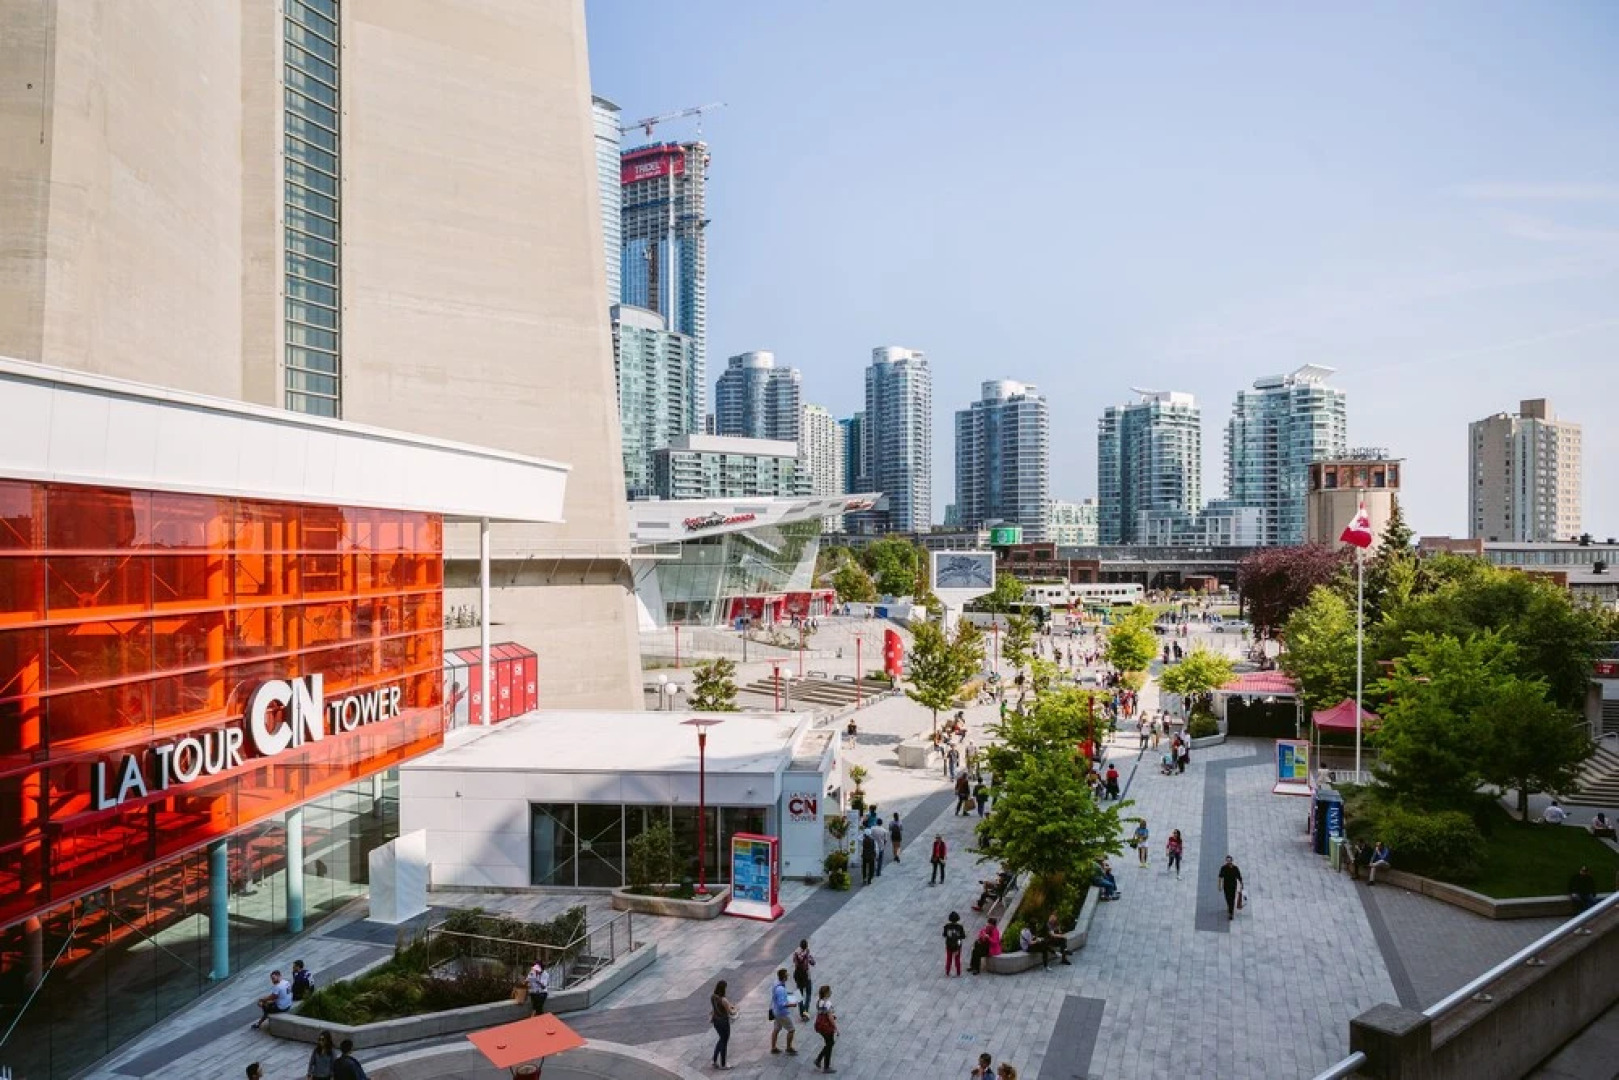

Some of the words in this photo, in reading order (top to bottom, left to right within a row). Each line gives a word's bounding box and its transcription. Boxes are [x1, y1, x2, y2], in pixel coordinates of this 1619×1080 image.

[95, 753, 148, 811] LA
[155, 727, 244, 791] TOUR
[249, 673, 325, 757] CN
[331, 686, 401, 736] TOWER
[788, 799, 817, 815] CN
